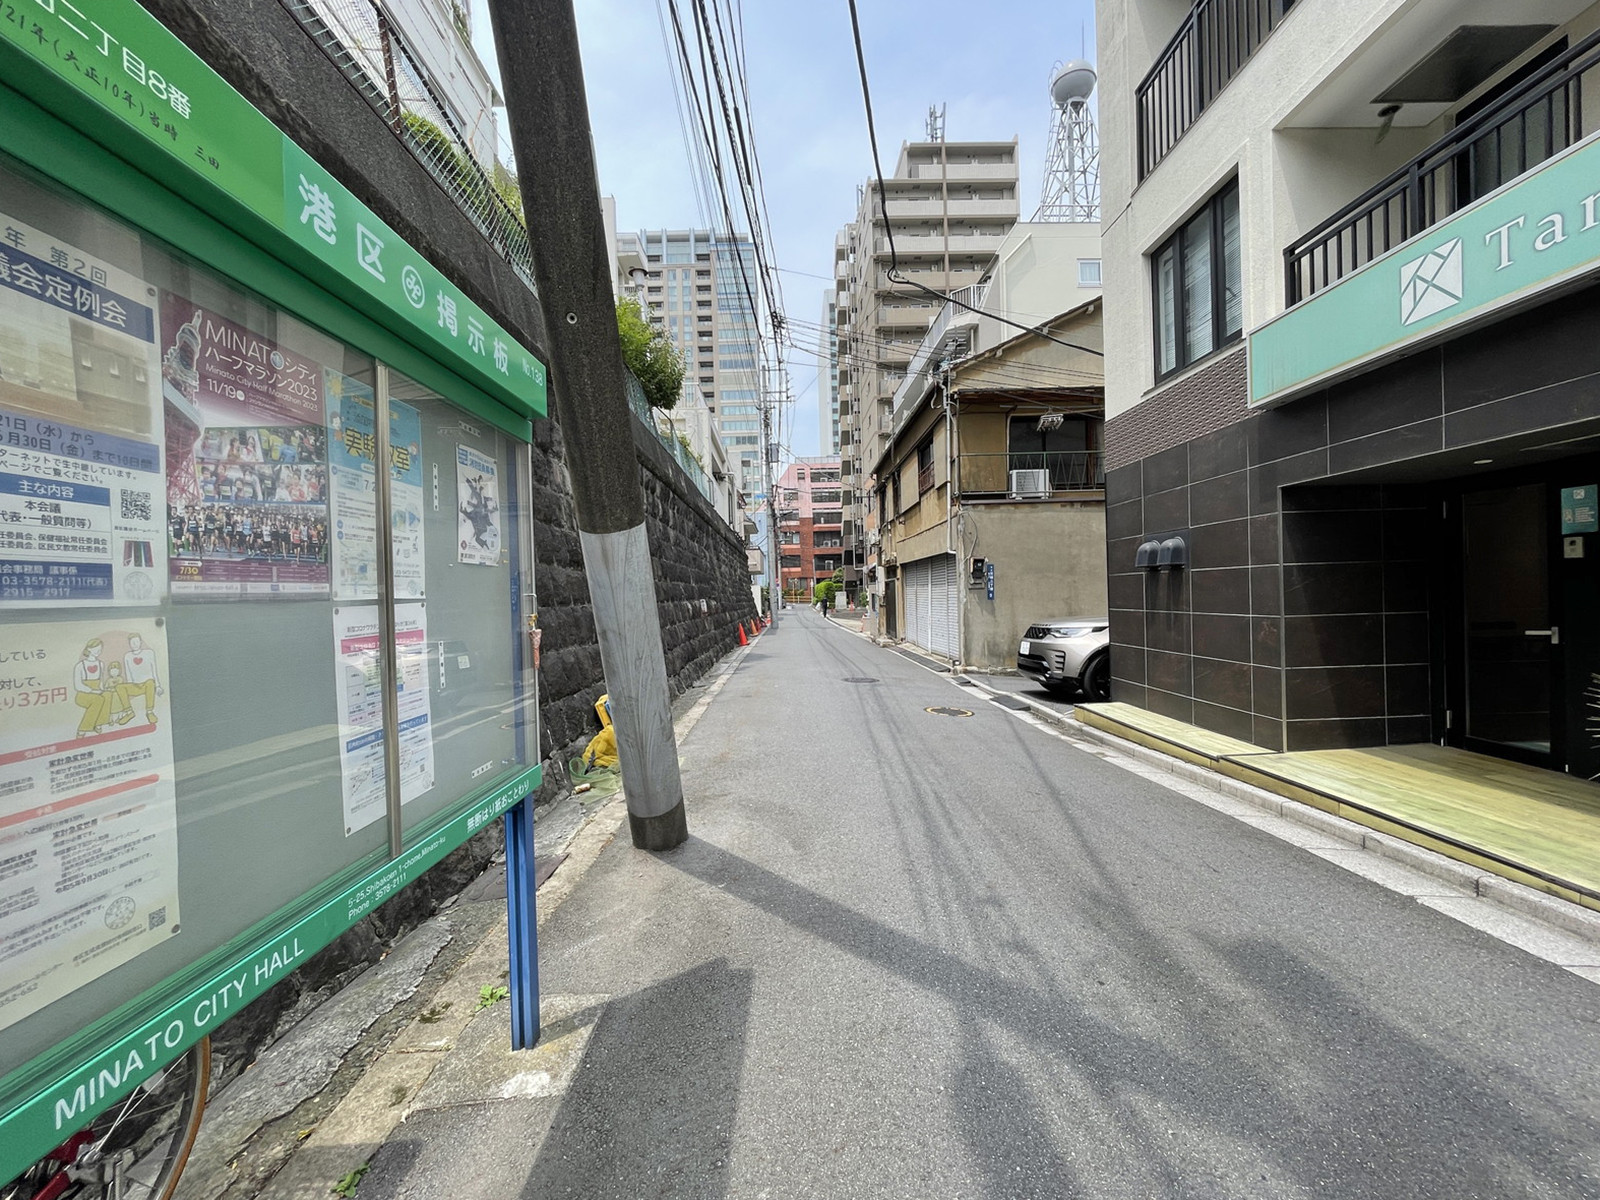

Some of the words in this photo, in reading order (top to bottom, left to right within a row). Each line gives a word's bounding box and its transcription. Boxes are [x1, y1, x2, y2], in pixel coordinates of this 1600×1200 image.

[34, 0, 192, 120] 二丁目8番
[5, 226, 26, 248] 年
[50, 245, 107, 288] 第2回
[298, 173, 387, 284] 港区
[437, 289, 510, 377] 掲示板
[522, 356, 544, 387] No.138
[205, 363, 236, 382] Minato
[206, 378, 236, 399] 11/19
[18, 479, 75, 499] 主な内容
[24, 500, 62, 514] 本会議
[0, 686, 68, 711] り3万円
[348, 900, 370, 921] Phone
[54, 1019, 185, 1131] MINATO
[193, 972, 247, 1027] CITY
[254, 937, 305, 986] HALL
